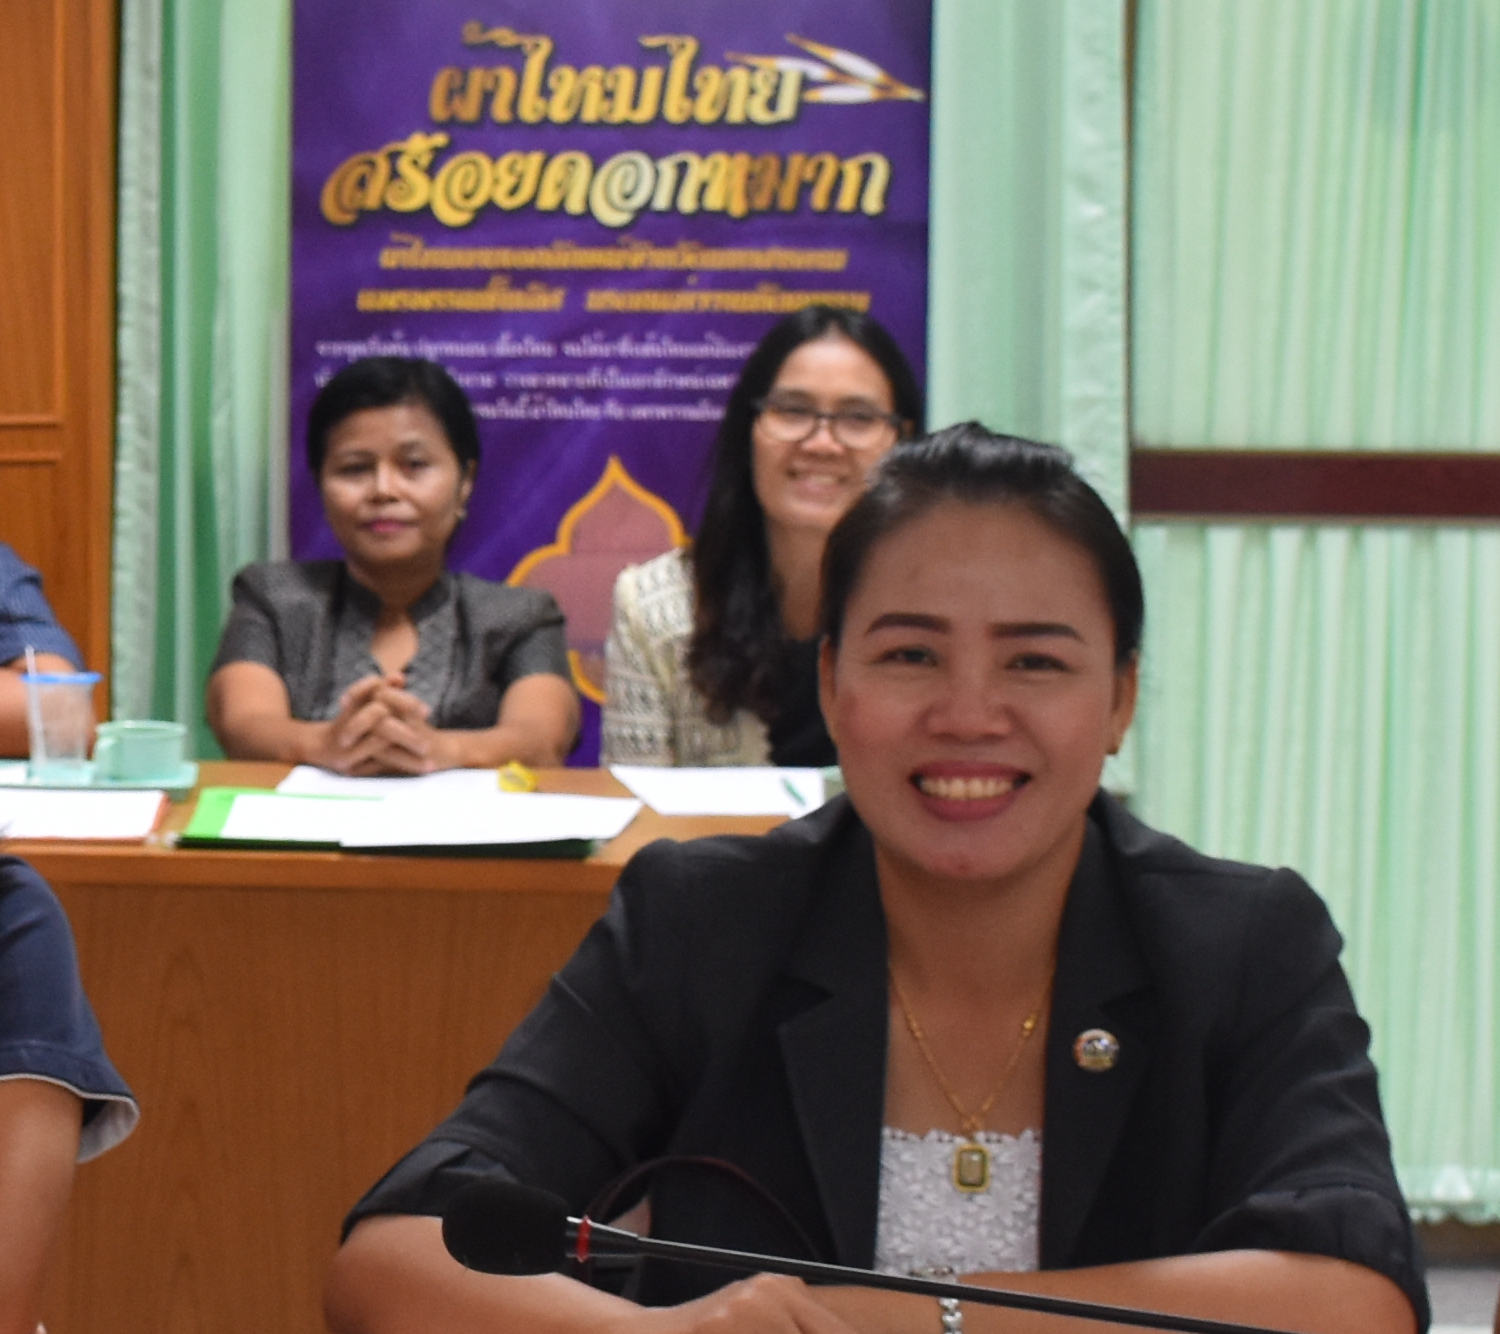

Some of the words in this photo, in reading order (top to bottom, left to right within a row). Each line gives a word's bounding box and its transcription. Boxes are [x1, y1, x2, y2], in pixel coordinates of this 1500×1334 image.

[429, 21, 803, 125] ผ้าไหมไทย
[321, 131, 891, 227] สร้อยดอกหมาก
